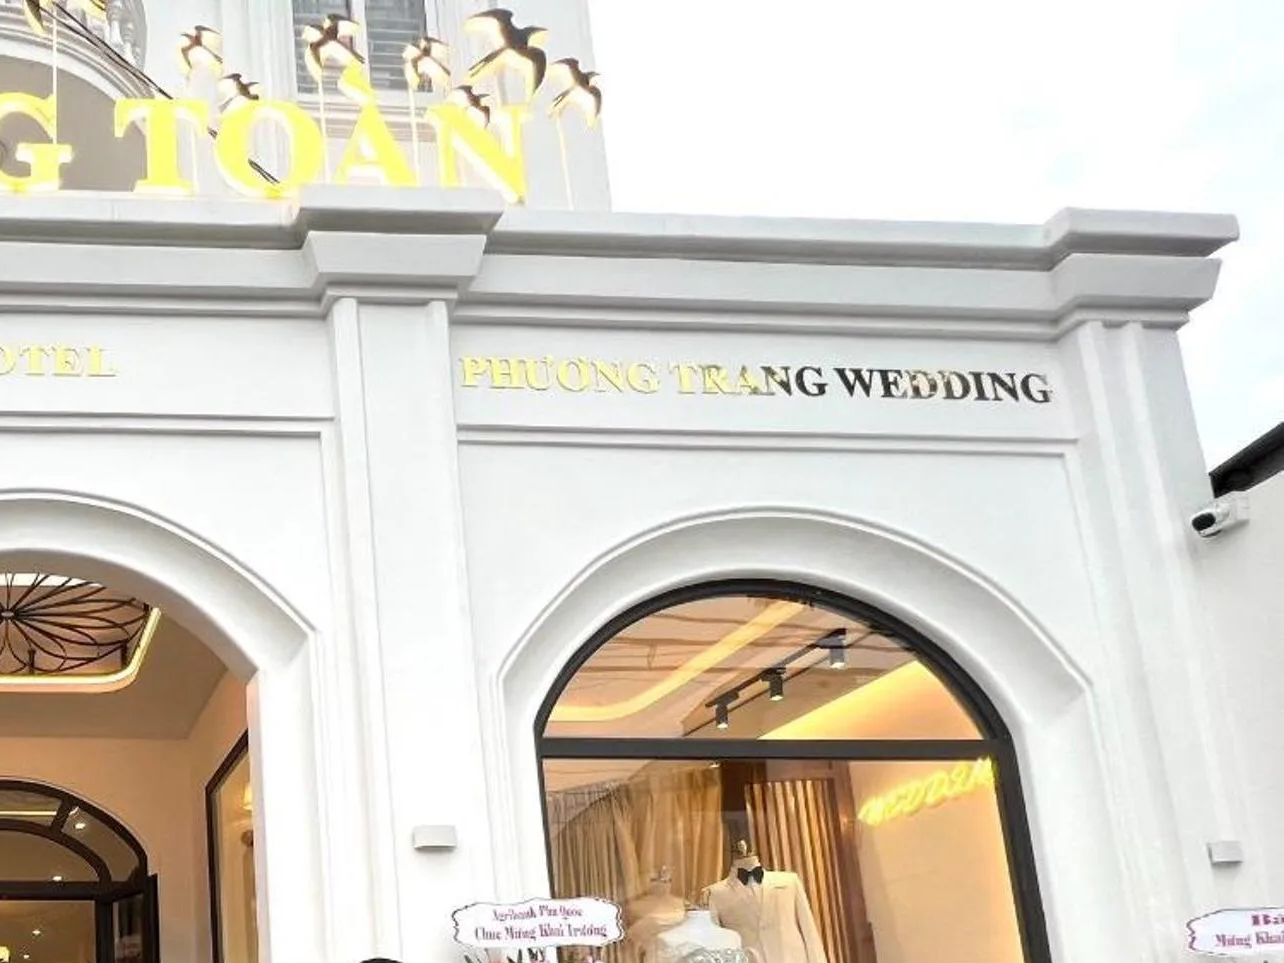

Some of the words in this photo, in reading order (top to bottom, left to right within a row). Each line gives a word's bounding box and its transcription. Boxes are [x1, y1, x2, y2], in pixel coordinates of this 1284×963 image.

[114, 62, 532, 203] TOÀN
[459, 355, 661, 395] PHƯƠNG
[668, 362, 828, 397] TRANG
[833, 366, 1054, 404] WEDDING
